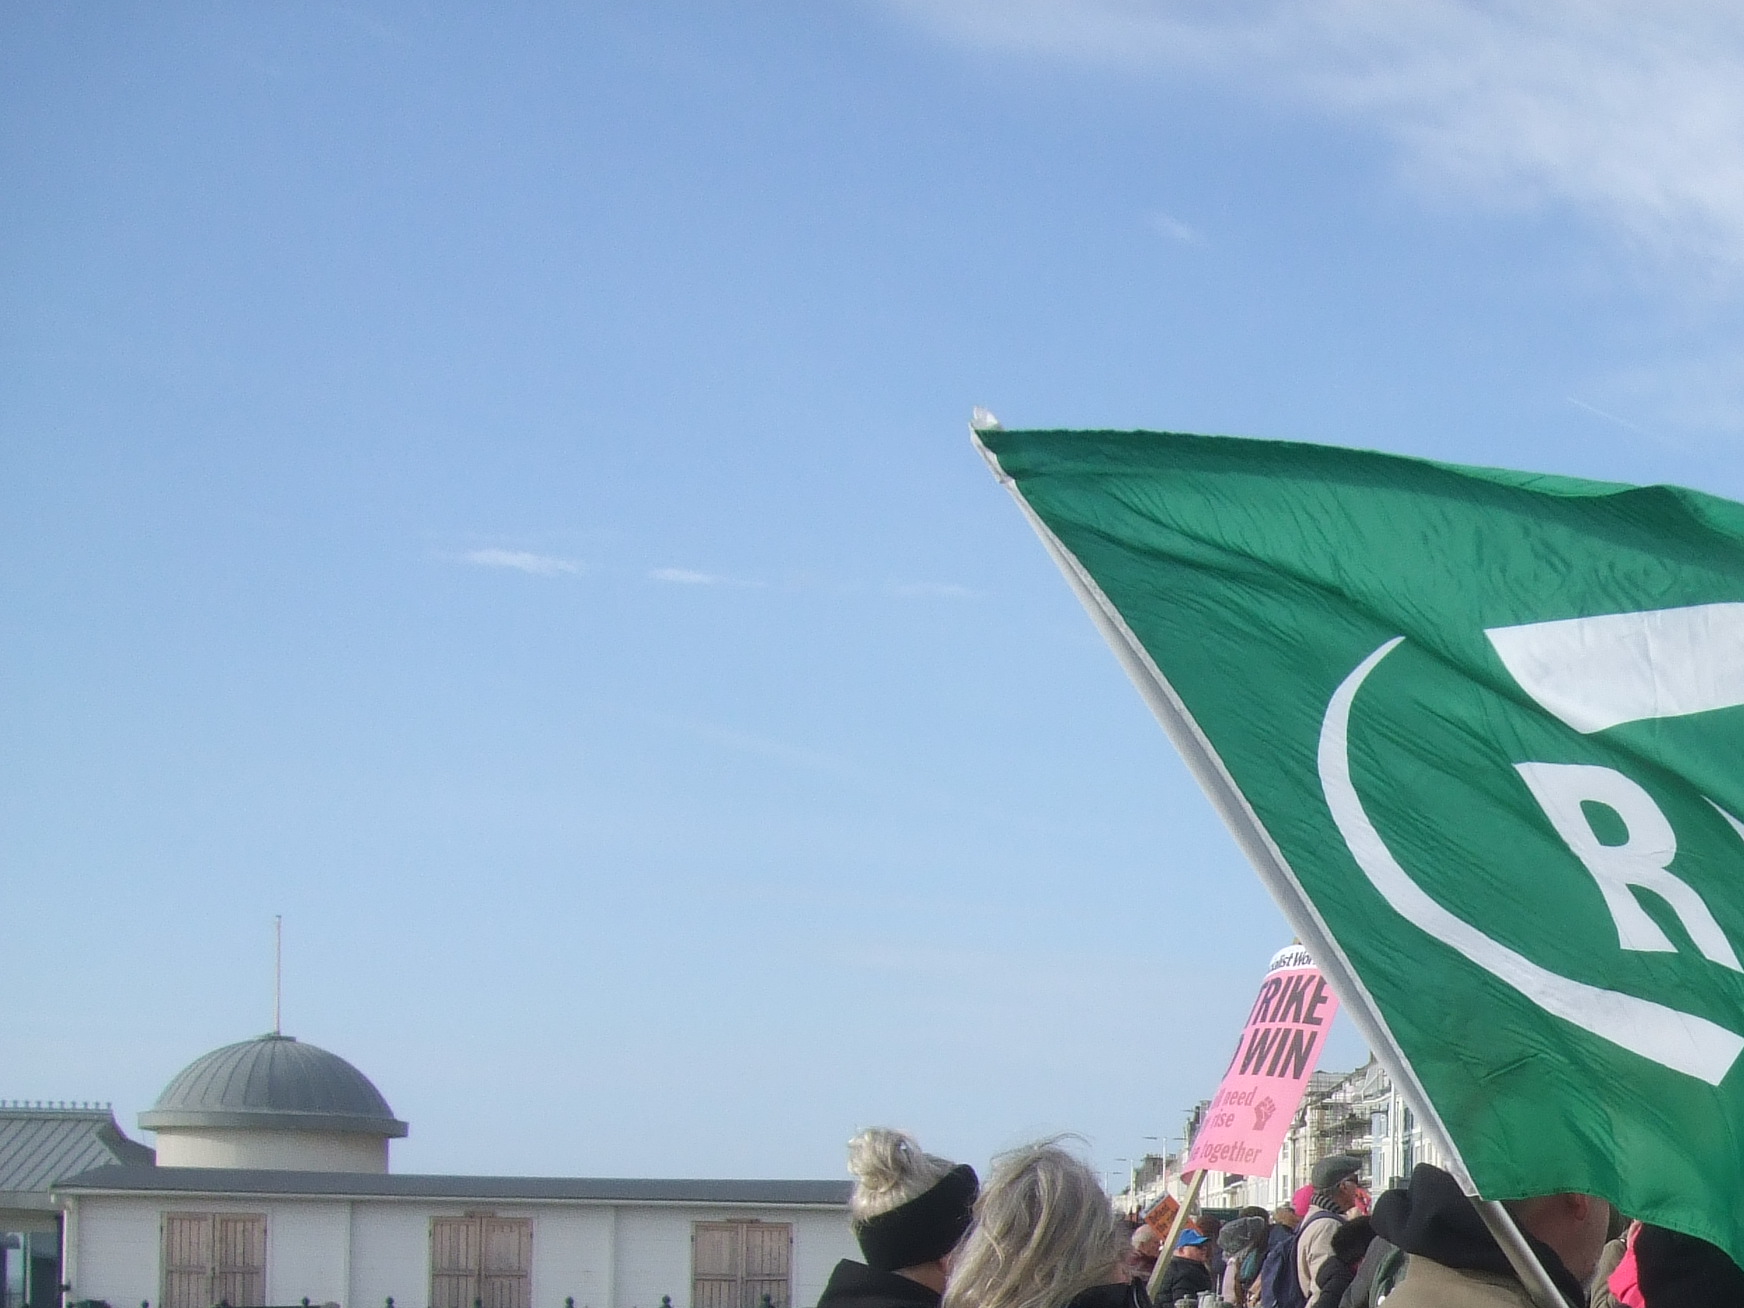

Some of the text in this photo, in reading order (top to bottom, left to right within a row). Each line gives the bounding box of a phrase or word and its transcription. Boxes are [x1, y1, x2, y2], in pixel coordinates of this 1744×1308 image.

[1293, 951, 1313, 967] Wor
[1244, 974, 1329, 1027] TRIKE
[1239, 1027, 1318, 1081] WIN
[1222, 1086, 1258, 1107] need
[1211, 1108, 1236, 1129] rise
[1200, 1140, 1264, 1164] together
